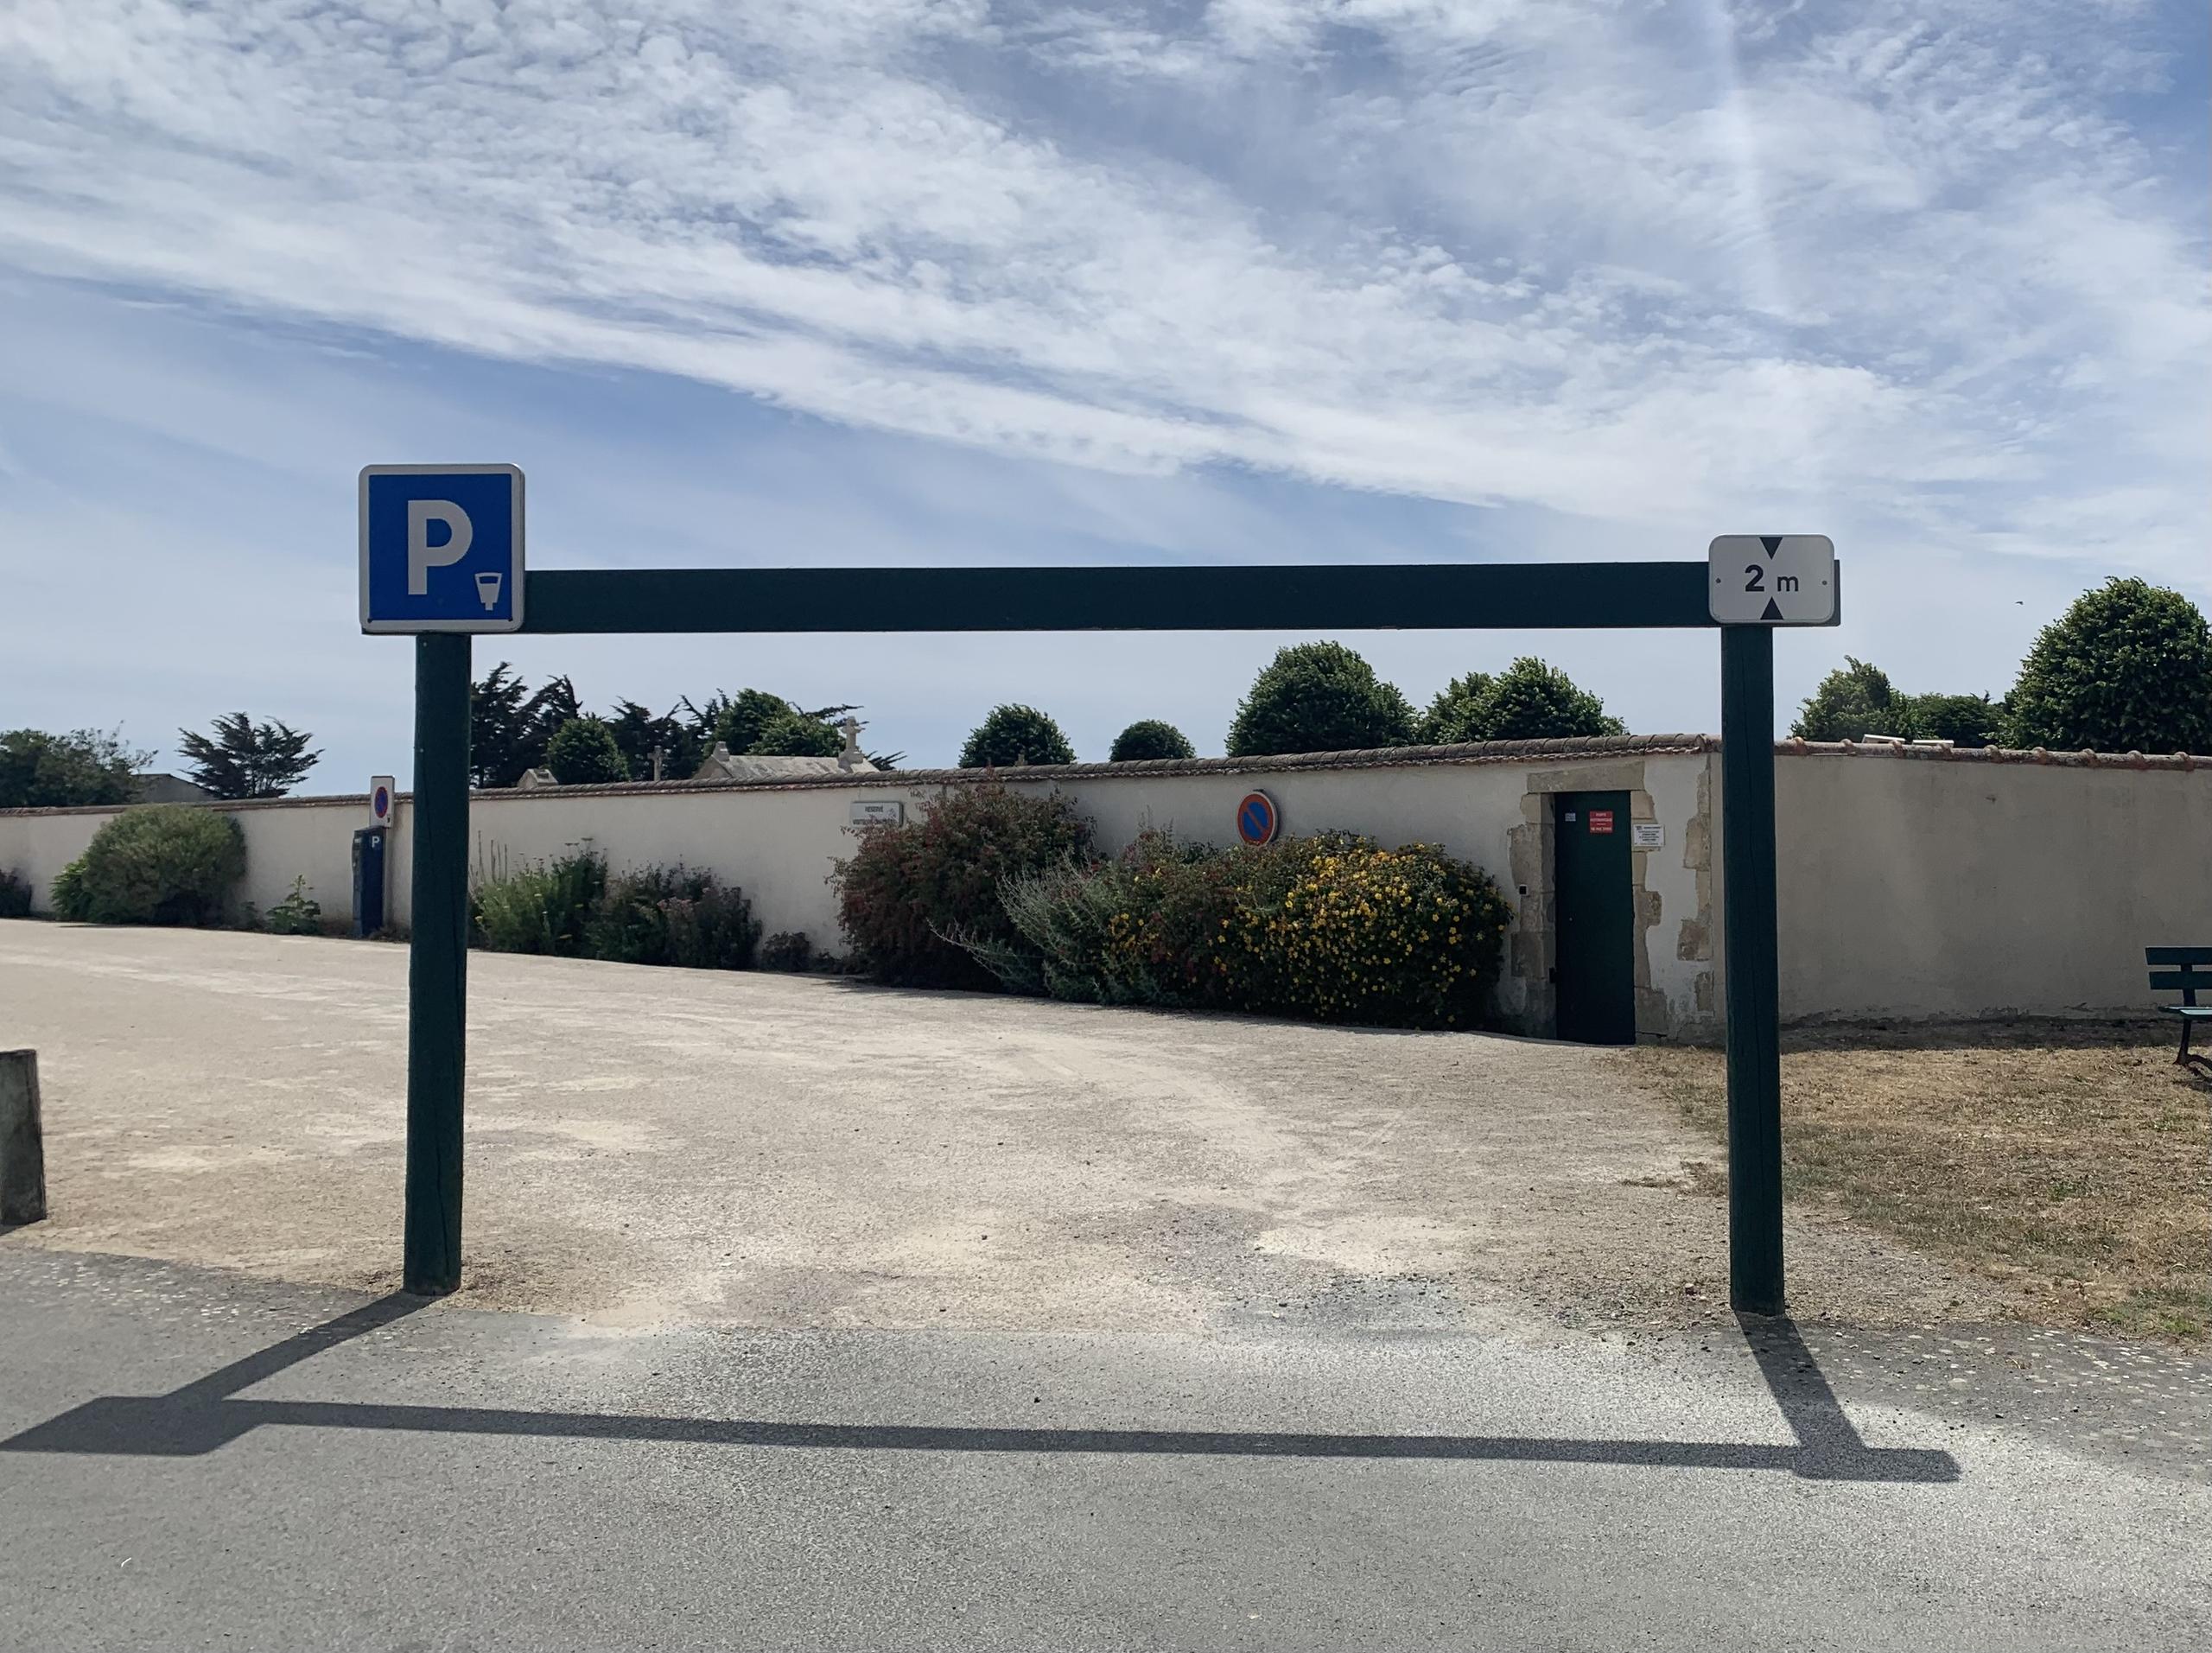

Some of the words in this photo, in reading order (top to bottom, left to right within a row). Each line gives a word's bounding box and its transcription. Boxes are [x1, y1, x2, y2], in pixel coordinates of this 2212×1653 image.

[408, 499, 473, 594] P
[1745, 564, 1764, 592] 2
[1777, 575, 1798, 592] m
[372, 836, 380, 848] P
